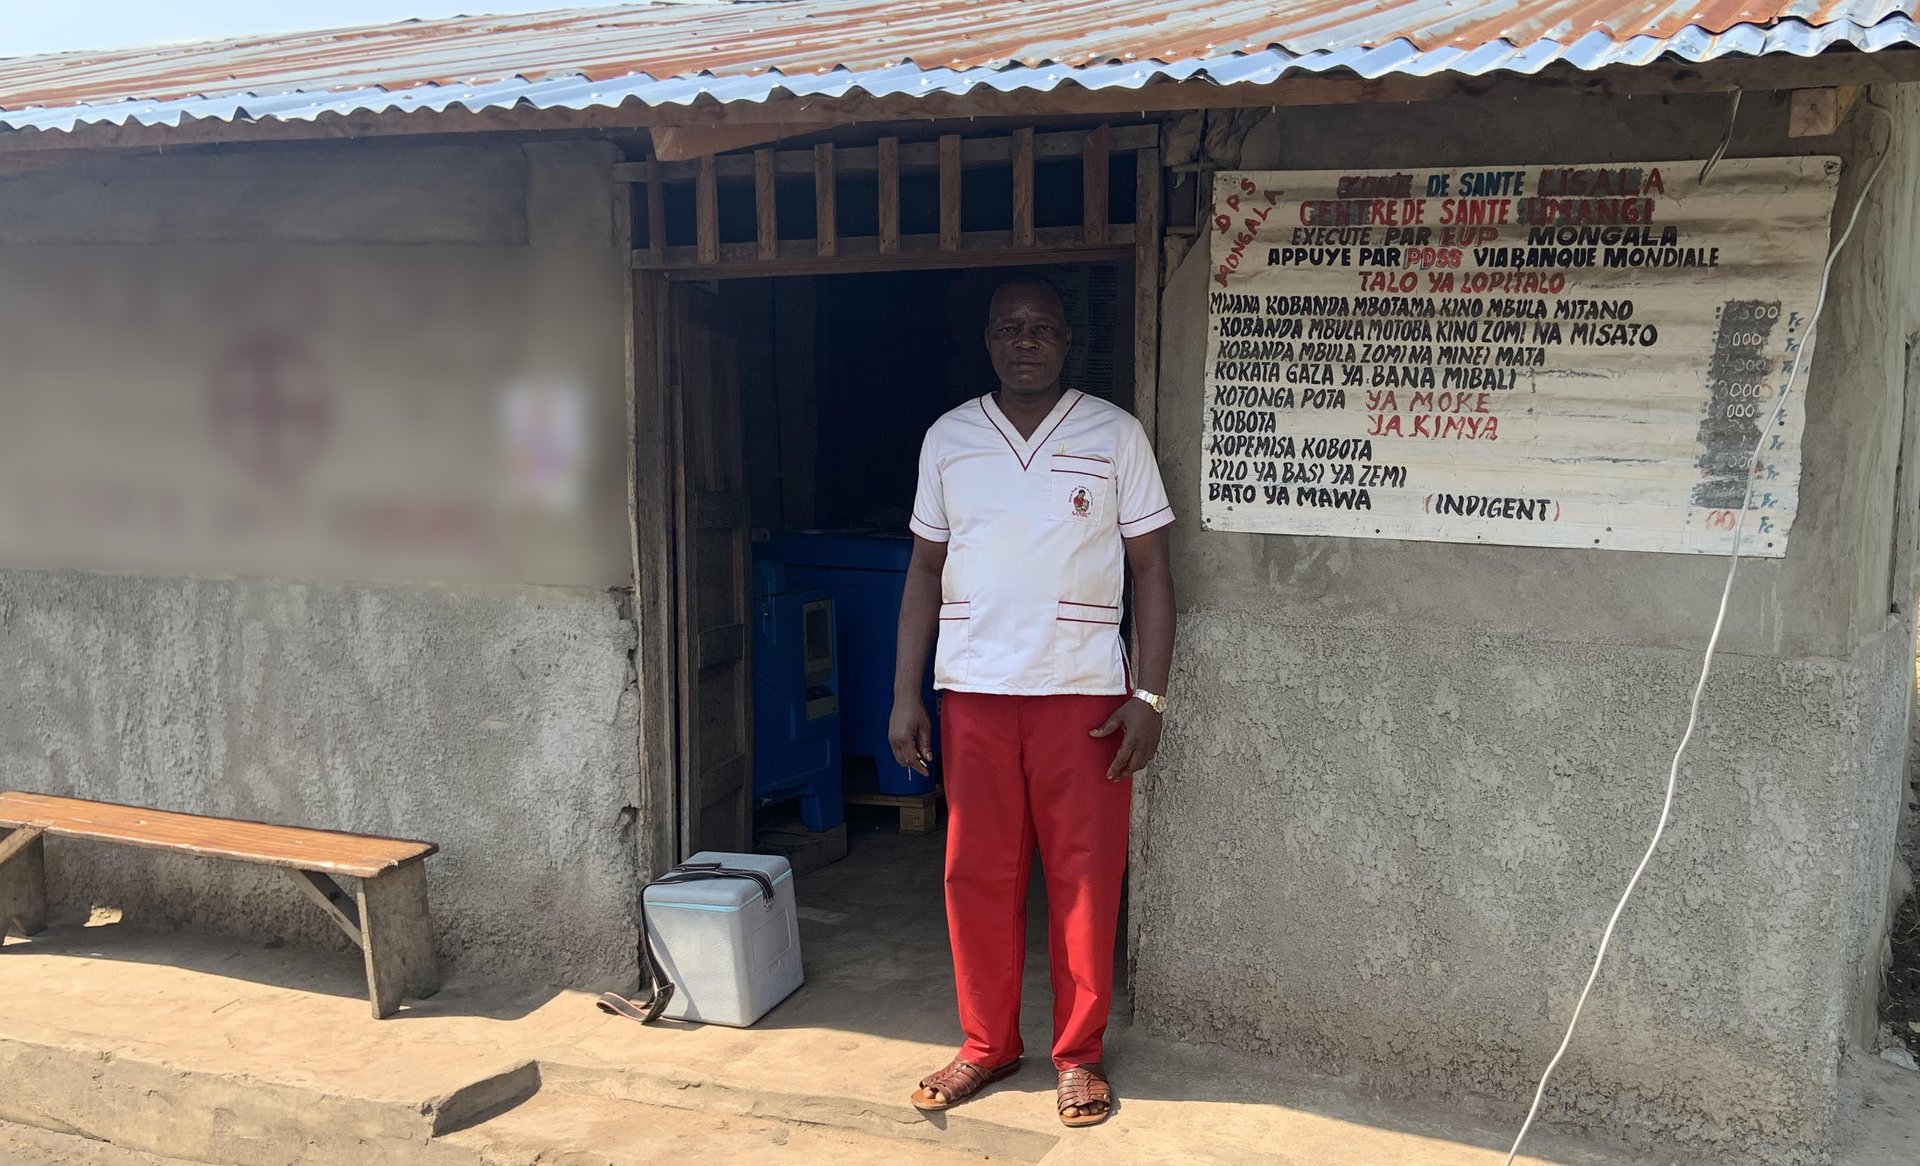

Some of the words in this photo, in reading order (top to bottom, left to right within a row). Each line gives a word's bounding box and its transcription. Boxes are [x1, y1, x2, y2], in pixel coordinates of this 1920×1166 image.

[1426, 174, 1450, 197] DE
[1458, 172, 1526, 197] SANTE
[1439, 199, 1511, 226] SANTE
[1214, 190, 1284, 288] MONGALA
[1291, 227, 1372, 246] EXECUTE
[1384, 227, 1432, 246] PAR
[1438, 227, 1499, 248] EUP
[1527, 226, 1677, 246] MONGALA
[1267, 248, 1351, 267] APPUYE
[1358, 248, 1401, 267] PAR
[1403, 248, 1463, 270] PDSS
[1603, 248, 1719, 268] MONDIALE
[1358, 271, 1419, 293] TALO
[1427, 271, 1455, 294] YA
[1460, 271, 1566, 294] LOPITALO
[1265, 296, 1350, 316] KOBANDA
[1352, 297, 1436, 318] MBOTAMA
[1438, 298, 1483, 318] KINO
[1486, 299, 1548, 320] MBULA
[1553, 300, 1634, 321] MITANO
[1219, 317, 1303, 341] KOBANDA
[1307, 320, 1365, 341] MBULA
[1366, 321, 1434, 343] MOTOBA
[1436, 321, 1478, 343] KINO
[1481, 322, 1528, 344] ZOMI
[1532, 323, 1563, 346] NA
[1570, 323, 1658, 347] MISATO
[1217, 340, 1295, 361] KOBANDA
[1299, 343, 1356, 364] MBULA
[1437, 347, 1491, 366] MINEI
[1495, 347, 1546, 367] MATA
[1214, 361, 1281, 383] KOKATA
[1285, 362, 1335, 386] GAZA
[1340, 363, 1364, 387] YA
[1371, 365, 1436, 389] BANA
[1442, 366, 1517, 391] MIBALI
[1213, 384, 1296, 409] KOTONGA
[1300, 387, 1347, 410] POTA
[1366, 388, 1399, 412] YA
[1408, 390, 1491, 414] MOKE
[1211, 409, 1277, 434] KOBOTA
[1367, 414, 1404, 438] YA
[1408, 414, 1499, 441] KIMYA
[1209, 434, 1297, 459] KOPEMISA
[1301, 436, 1373, 461] KOBOTA
[1208, 458, 1248, 481] KILO
[1253, 461, 1278, 483] YA
[1281, 462, 1325, 484] BASI
[1329, 463, 1355, 485] YA
[1357, 465, 1408, 488] ZEMI
[1208, 482, 1257, 503] BATO
[1263, 485, 1290, 505] YA
[1296, 486, 1372, 510] MAWA
